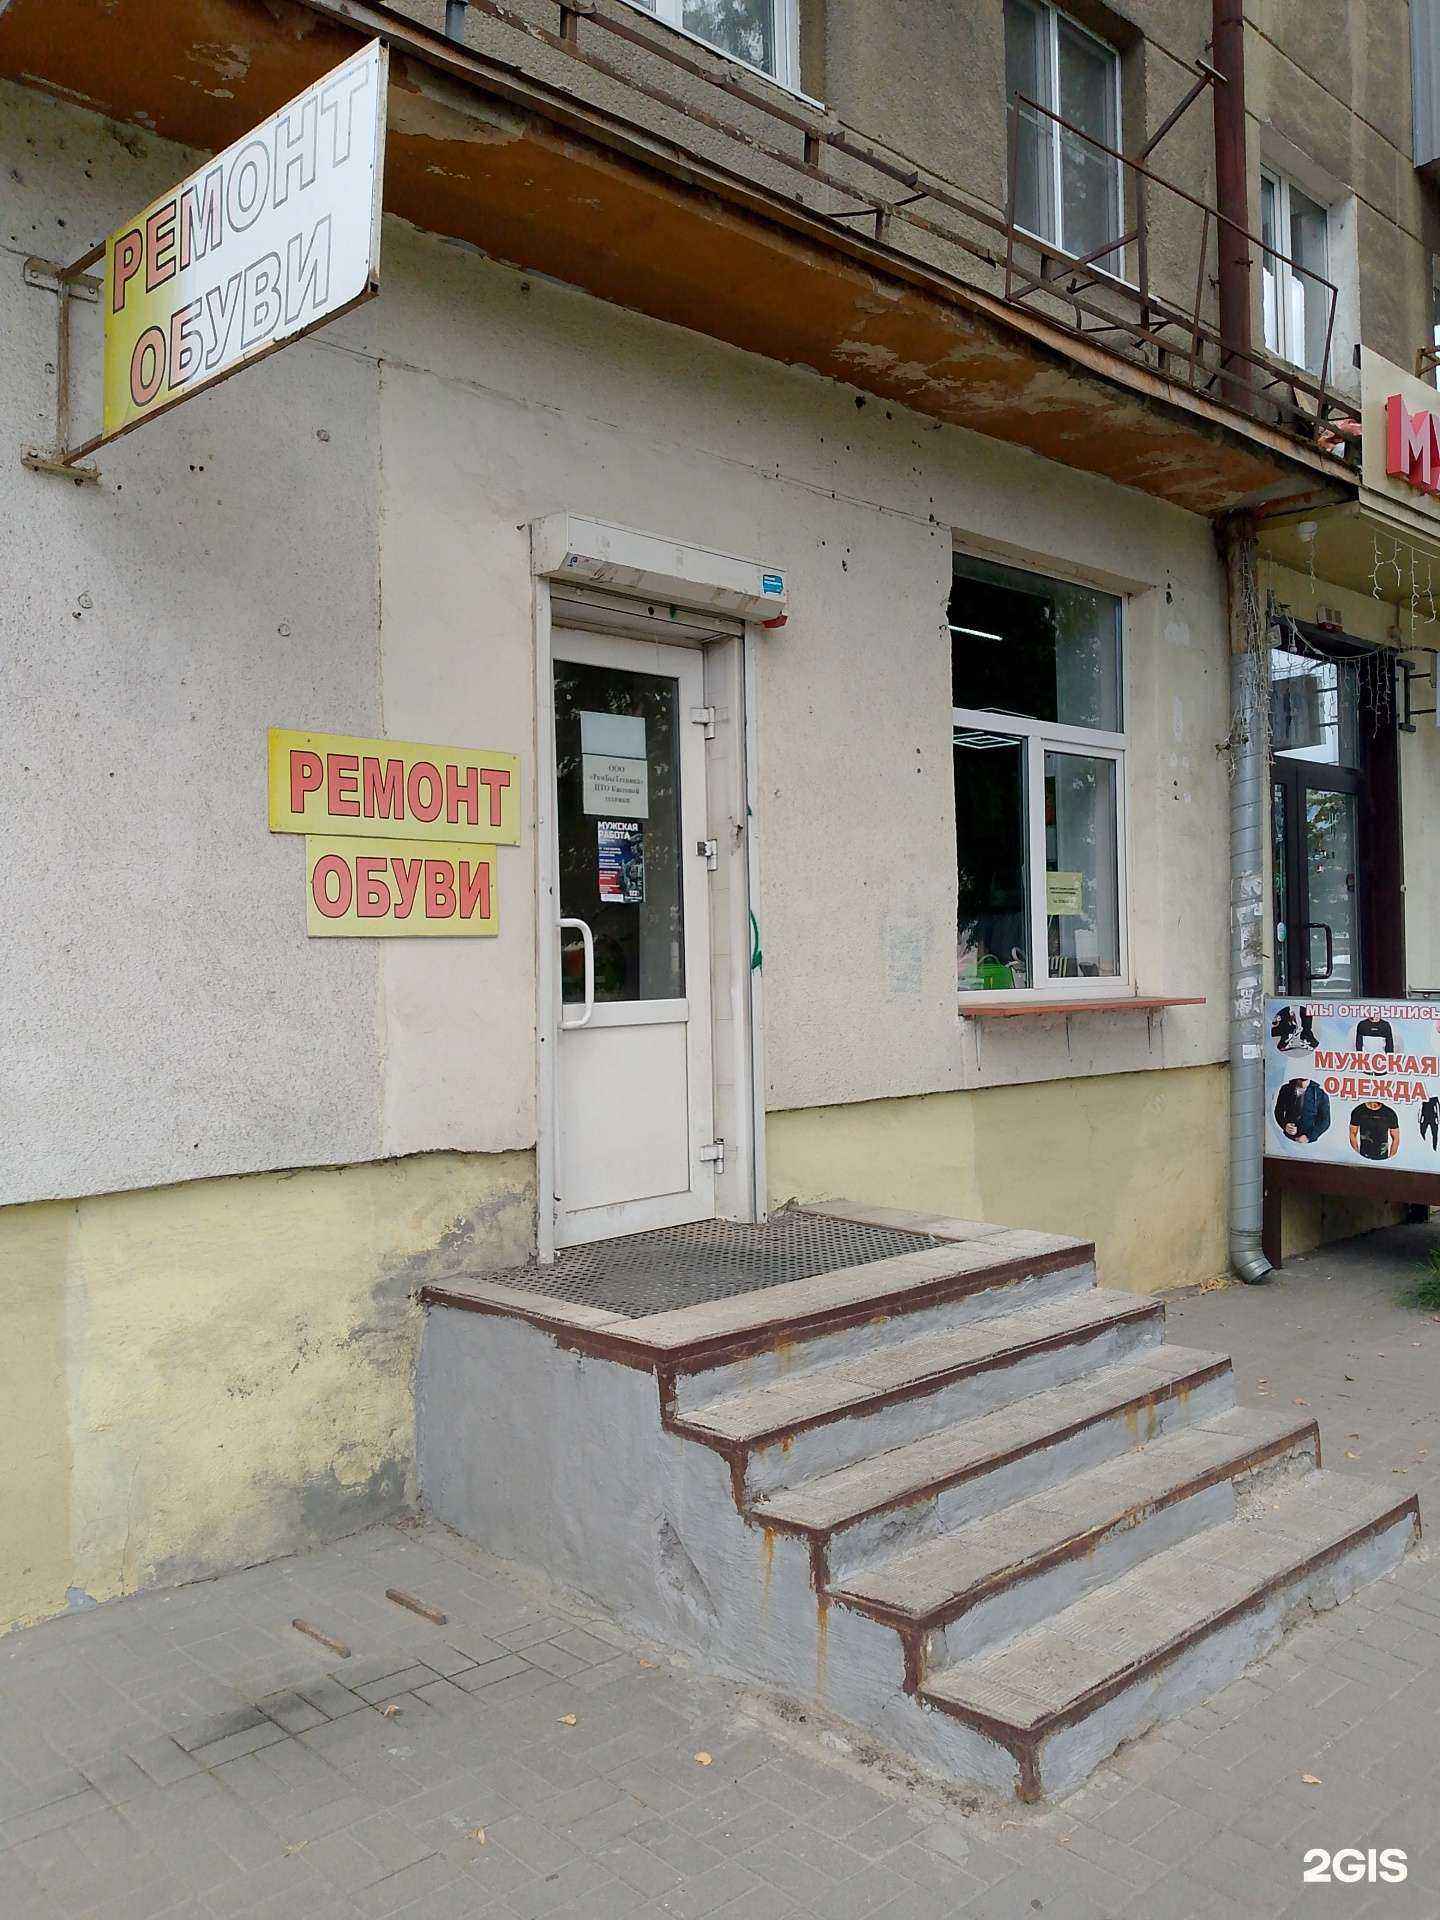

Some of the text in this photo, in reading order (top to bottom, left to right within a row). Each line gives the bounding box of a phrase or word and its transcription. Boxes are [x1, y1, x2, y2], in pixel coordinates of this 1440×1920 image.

[112, 59, 370, 314] РЕМОНТ
[130, 213, 332, 407] ОБУВИ
[289, 749, 511, 827] РЕМОНТ
[598, 821, 639, 832] МУЖСКАЯ
[598, 830, 631, 840] РАБОТА
[311, 854, 491, 919] ОБУВИ
[1305, 1004, 1440, 1019] МЫ ОТКРЫЛИСЬ
[1314, 1050, 1438, 1076] МУЖСКАЯ
[1323, 1076, 1429, 1103] ОДЕЖДА
